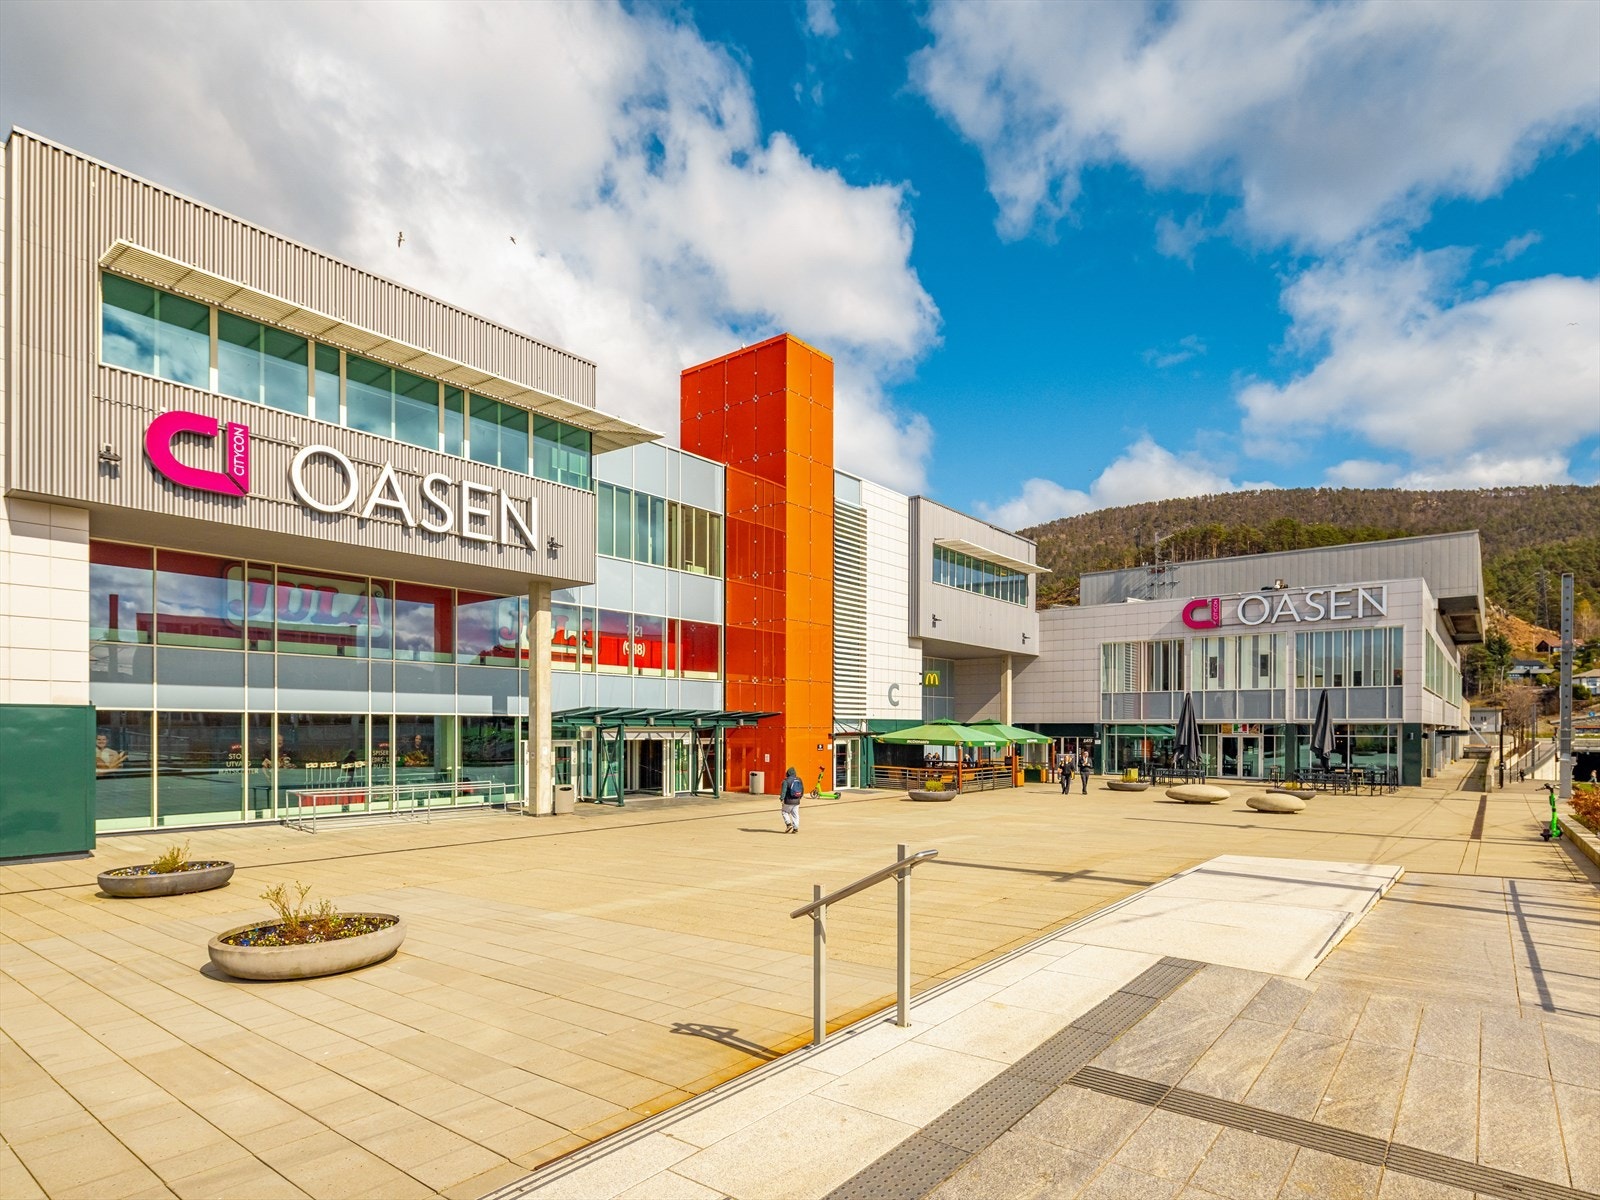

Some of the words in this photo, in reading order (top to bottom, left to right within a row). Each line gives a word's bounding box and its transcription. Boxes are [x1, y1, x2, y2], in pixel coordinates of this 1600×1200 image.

[233, 426, 245, 477] CITYCON
[290, 444, 538, 551] OASEN
[227, 577, 383, 626] JULA
[1237, 584, 1388, 626] OASEN
[626, 624, 643, 638] 721
[622, 640, 646, 657] (918)
[887, 682, 900, 707] C
[225, 760, 252, 768] UTVAG
